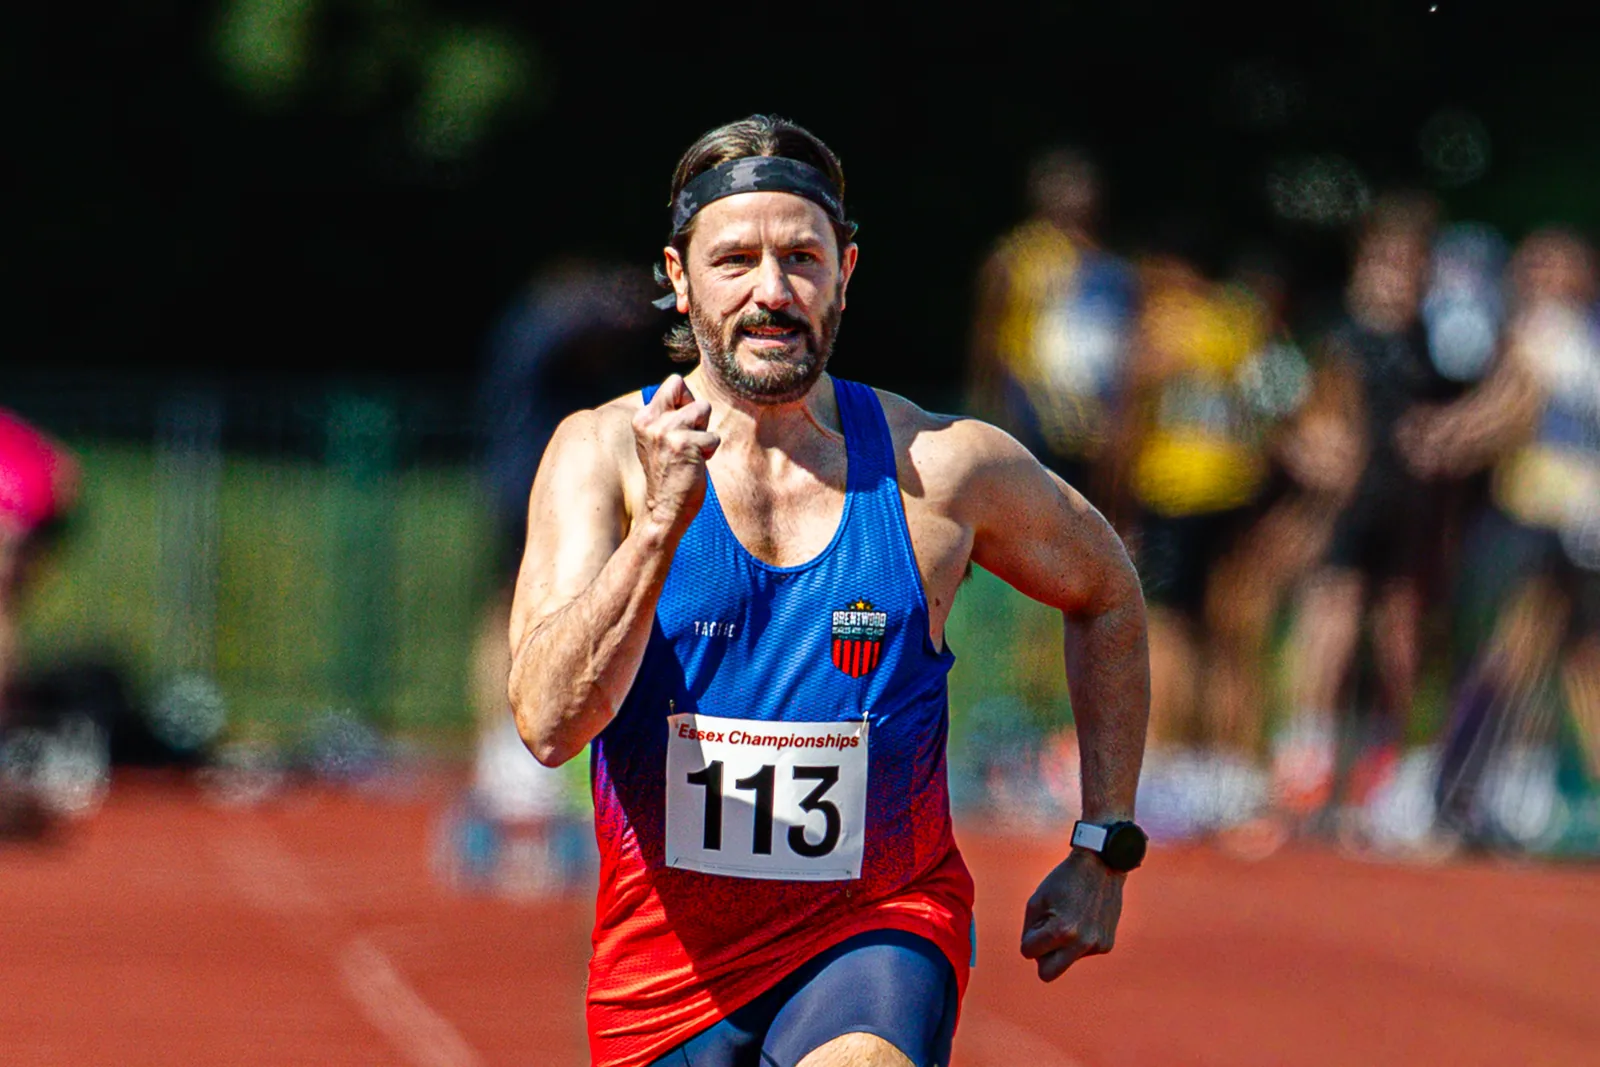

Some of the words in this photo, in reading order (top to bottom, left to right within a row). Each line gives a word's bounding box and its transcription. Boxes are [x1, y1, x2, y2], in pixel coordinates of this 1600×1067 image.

[832, 611, 886, 627] BRENTWOOD
[678, 724, 725, 743] Essex
[728, 730, 860, 751] Championships
[687, 760, 841, 858] 113
